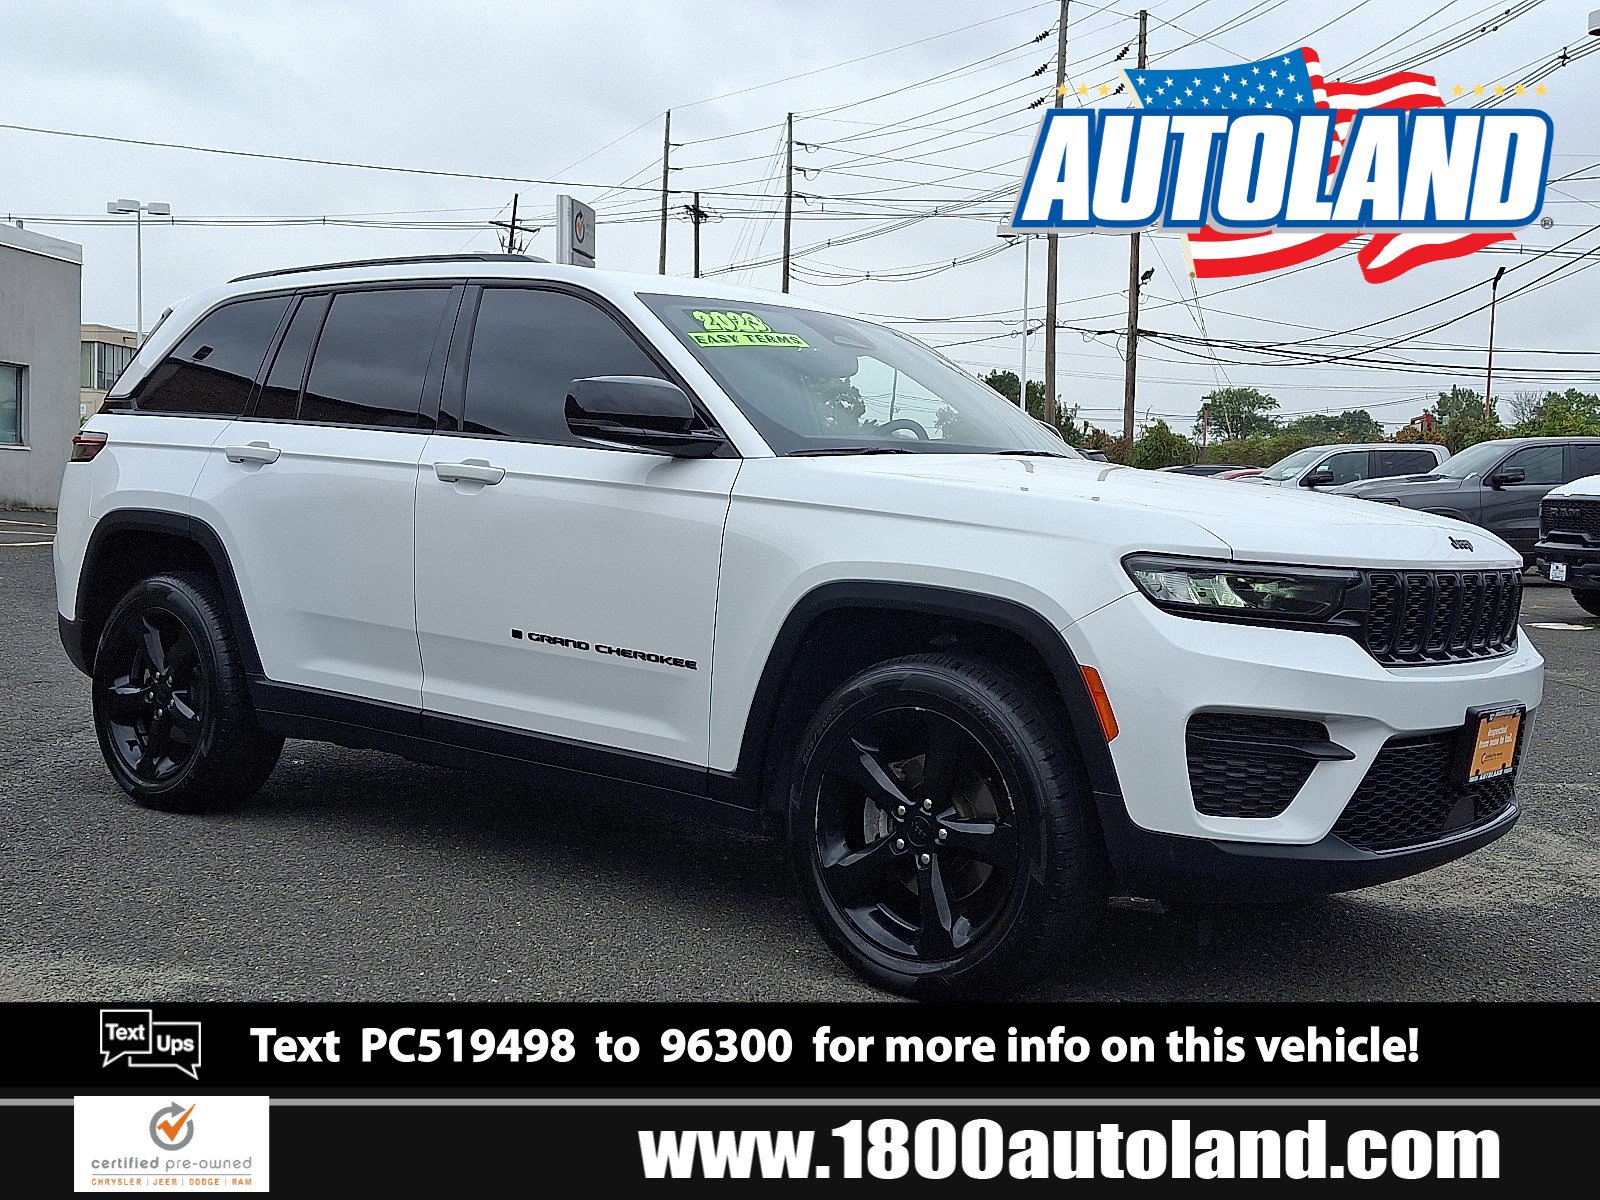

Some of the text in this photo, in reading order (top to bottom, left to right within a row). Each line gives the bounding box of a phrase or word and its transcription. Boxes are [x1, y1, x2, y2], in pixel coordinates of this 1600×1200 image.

[694, 334, 802, 345] EASY TERMS
[527, 632, 698, 671] GRAND CHEROKEE
